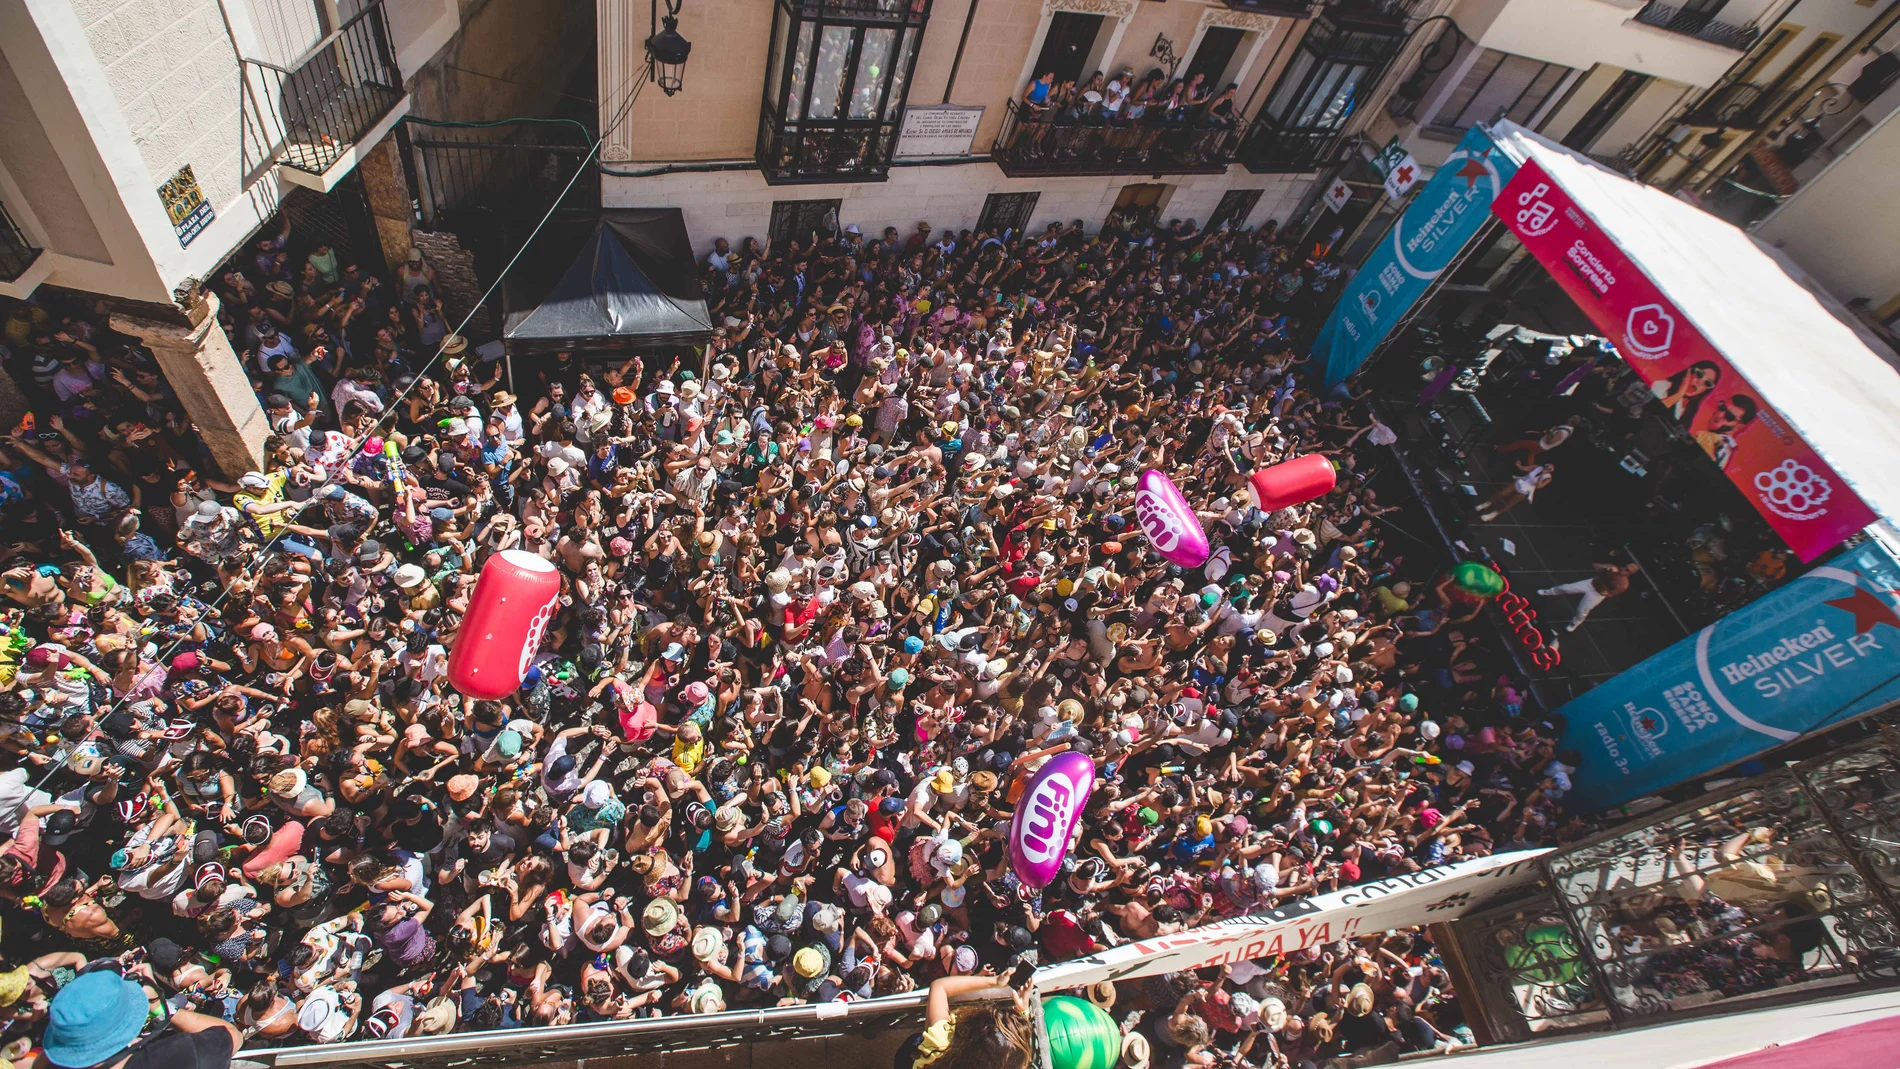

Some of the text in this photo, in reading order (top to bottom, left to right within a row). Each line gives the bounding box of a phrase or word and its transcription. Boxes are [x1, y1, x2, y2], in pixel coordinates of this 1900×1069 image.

[1406, 191, 1460, 252] Heineken
[1422, 185, 1480, 252] SILVER
[1383, 267, 1400, 292] RAMA
[1387, 261, 1406, 284] SONO
[1566, 246, 1609, 294] Sorpresa
[1574, 239, 1616, 285] Concierto
[1343, 315, 1357, 336] radio
[1720, 625, 1836, 685] Heineken
[1755, 632, 1884, 698] SILVER
[1662, 690, 1697, 733] RIBERA
[1671, 685, 1707, 729] RAMA
[1682, 681, 1719, 724] SONO
[1593, 720, 1621, 758] radio
[1623, 701, 1664, 757] Heineken
[1298, 922, 1331, 949] YA
